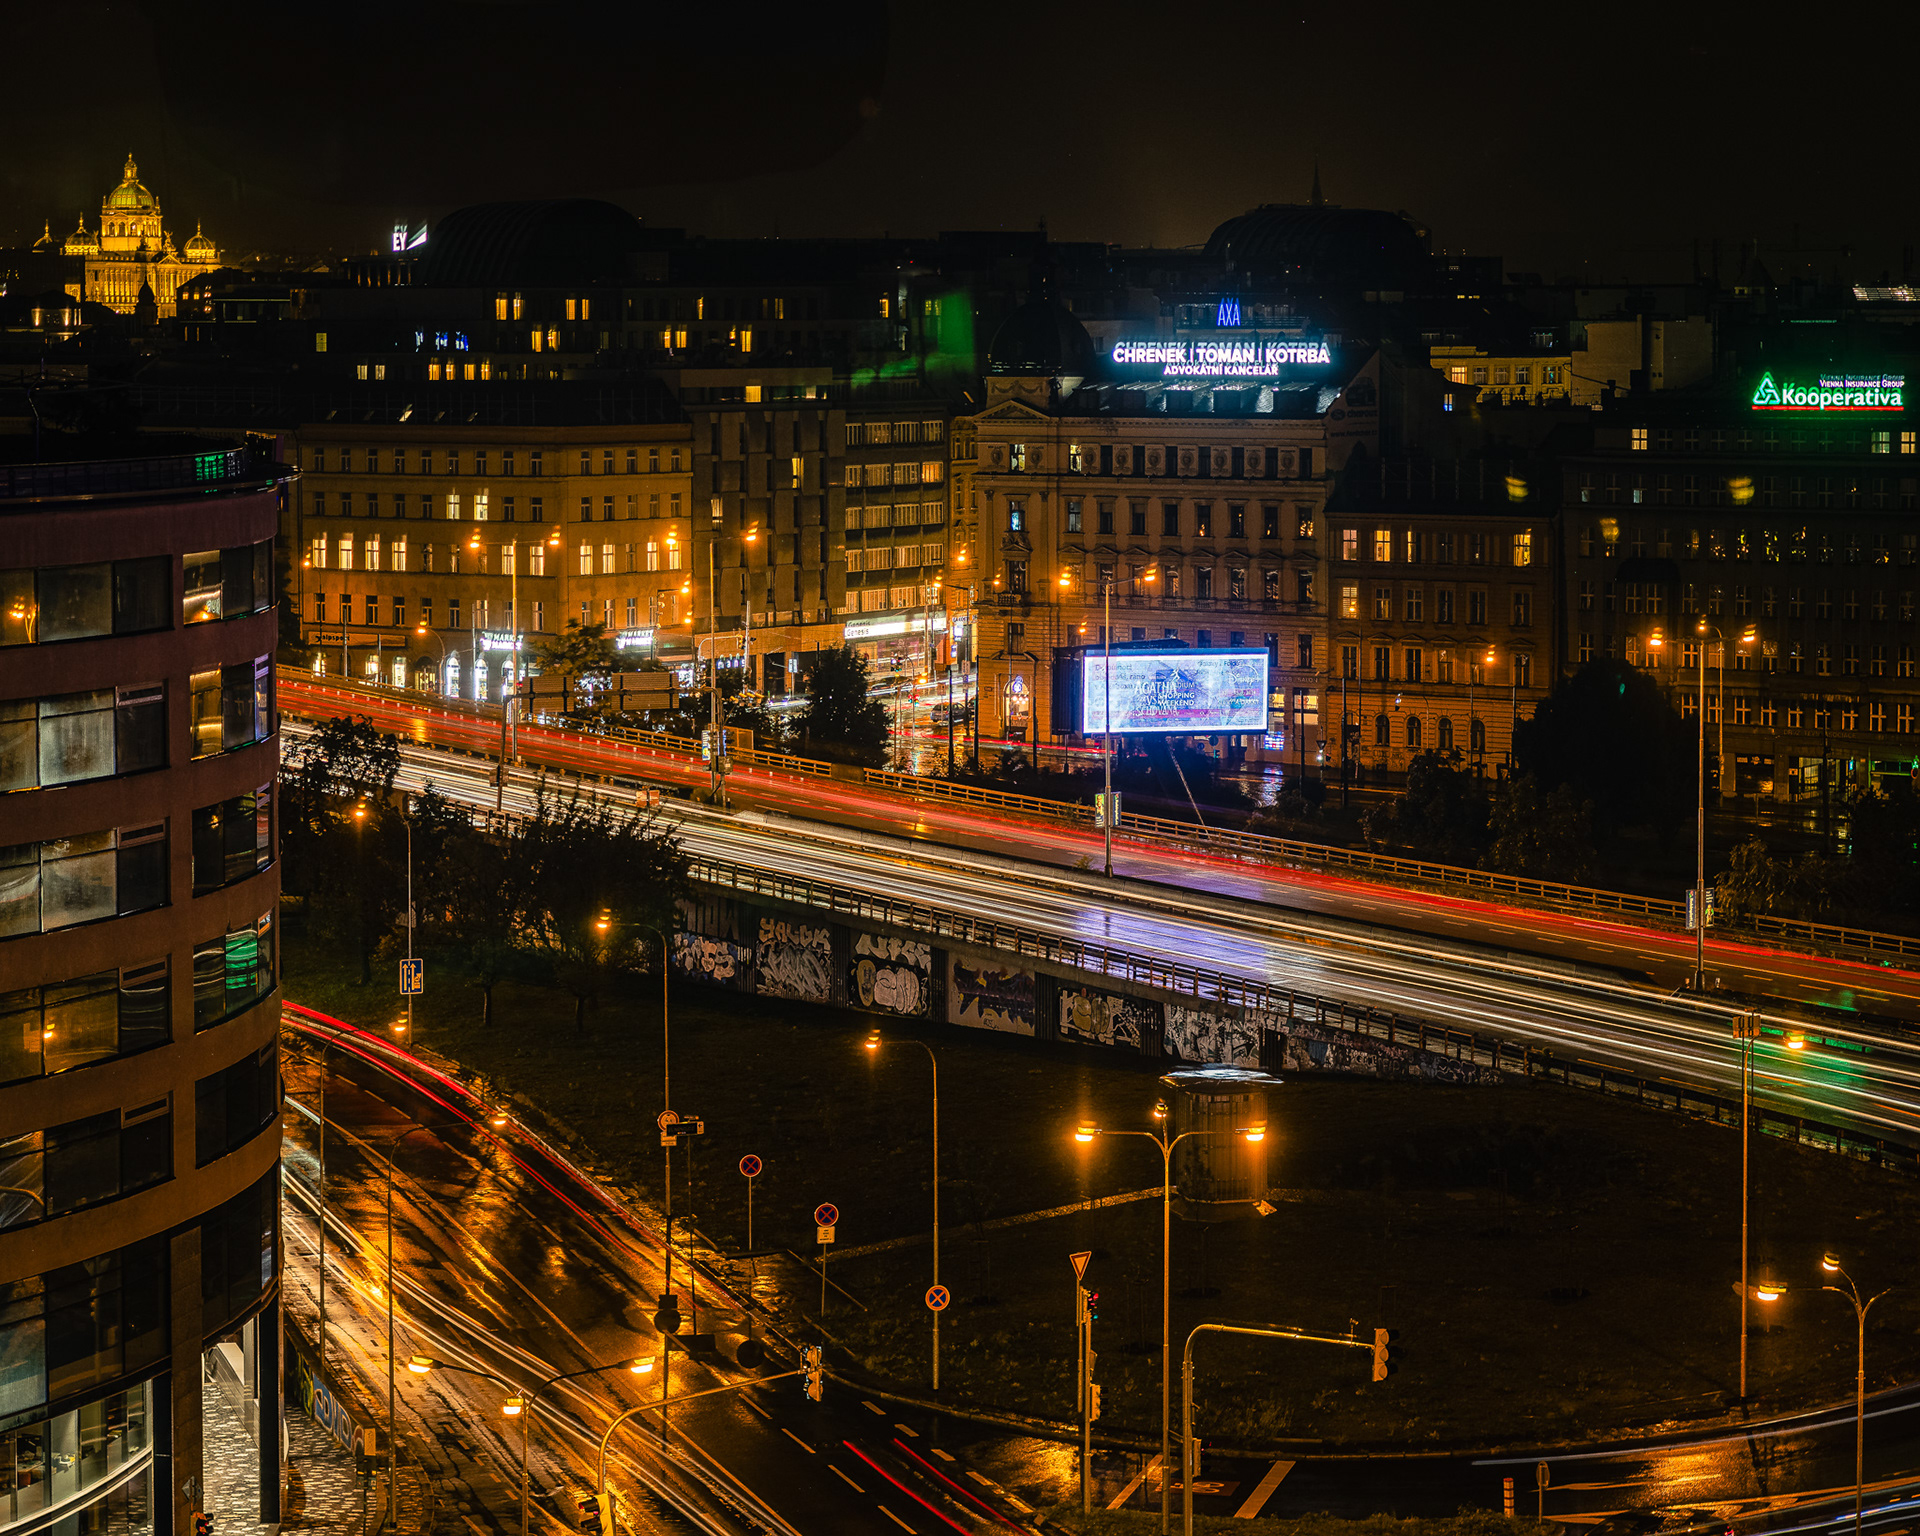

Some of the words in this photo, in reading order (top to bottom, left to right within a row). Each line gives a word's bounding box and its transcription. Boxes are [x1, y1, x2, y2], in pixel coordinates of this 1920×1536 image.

[392, 232, 408, 251] EY
[1217, 303, 1241, 326] AXA
[1112, 348, 1186, 363] CHRENEK
[1196, 348, 1255, 363] TOMAN
[1265, 348, 1330, 363] KOTRBA
[1163, 364, 1223, 376] ADVOKÁTNÍ
[1782, 388, 1902, 410] Kooperativa
[846, 628, 869, 637] Genesis
